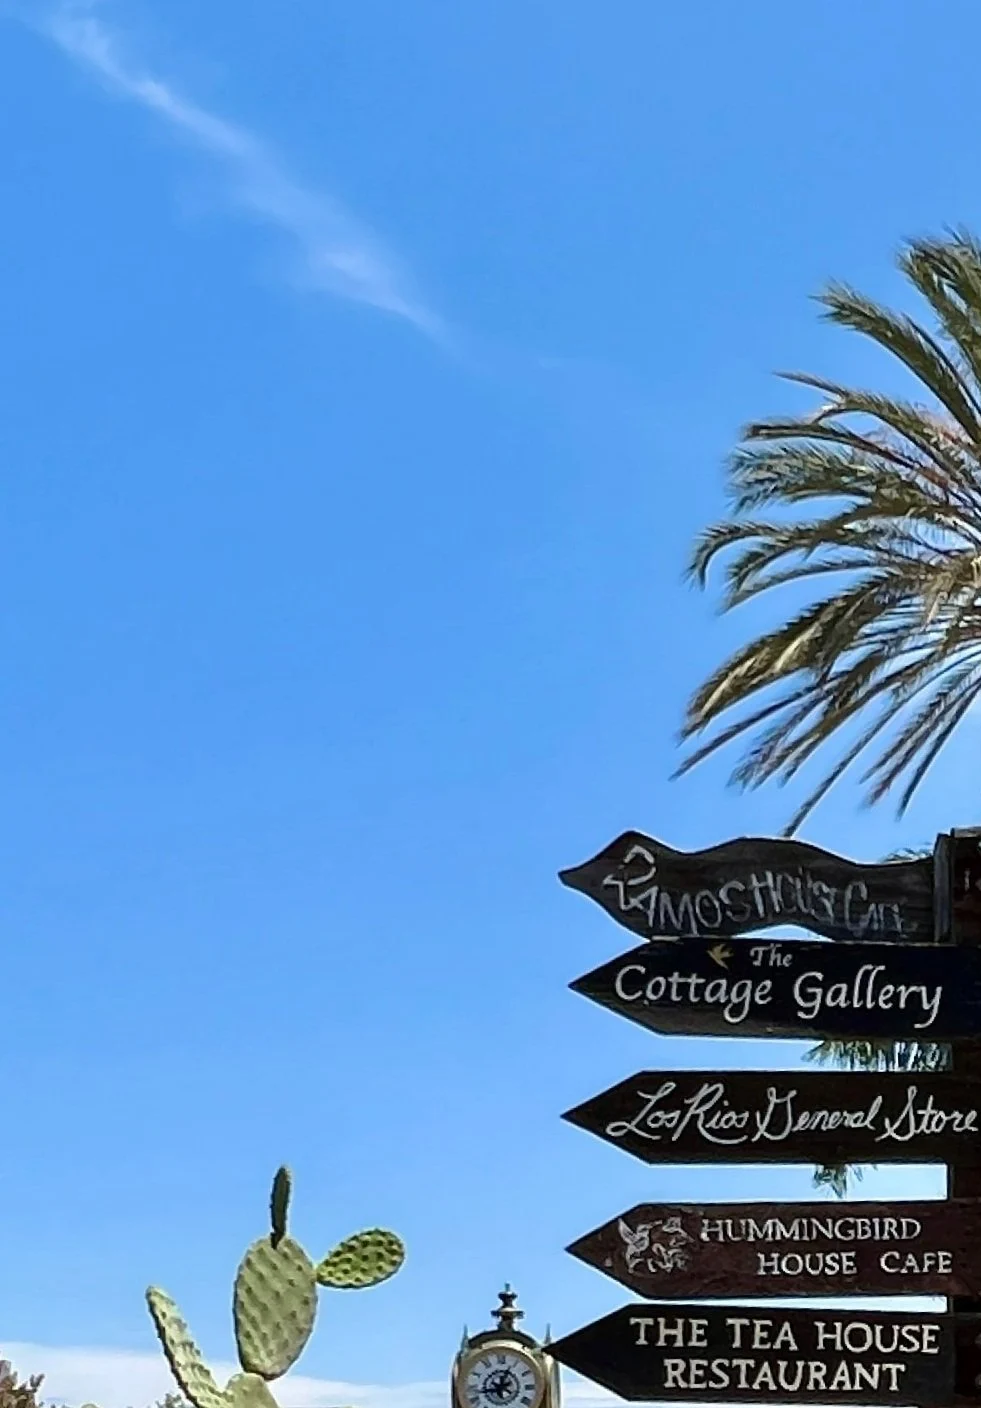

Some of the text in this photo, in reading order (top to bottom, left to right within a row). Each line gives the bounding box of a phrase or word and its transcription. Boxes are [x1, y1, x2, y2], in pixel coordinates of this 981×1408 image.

[750, 943, 793, 968] The
[614, 963, 943, 1029] Cottage Gallery
[751, 1087, 879, 1142] General
[876, 1085, 979, 1143] Store
[700, 1217, 922, 1243] HUMMINGBIRD
[757, 1251, 953, 1276] HOUSE CAFE
[630, 1317, 941, 1354] THE TEA HOUSE
[663, 1358, 906, 1392] RESTAURANT
